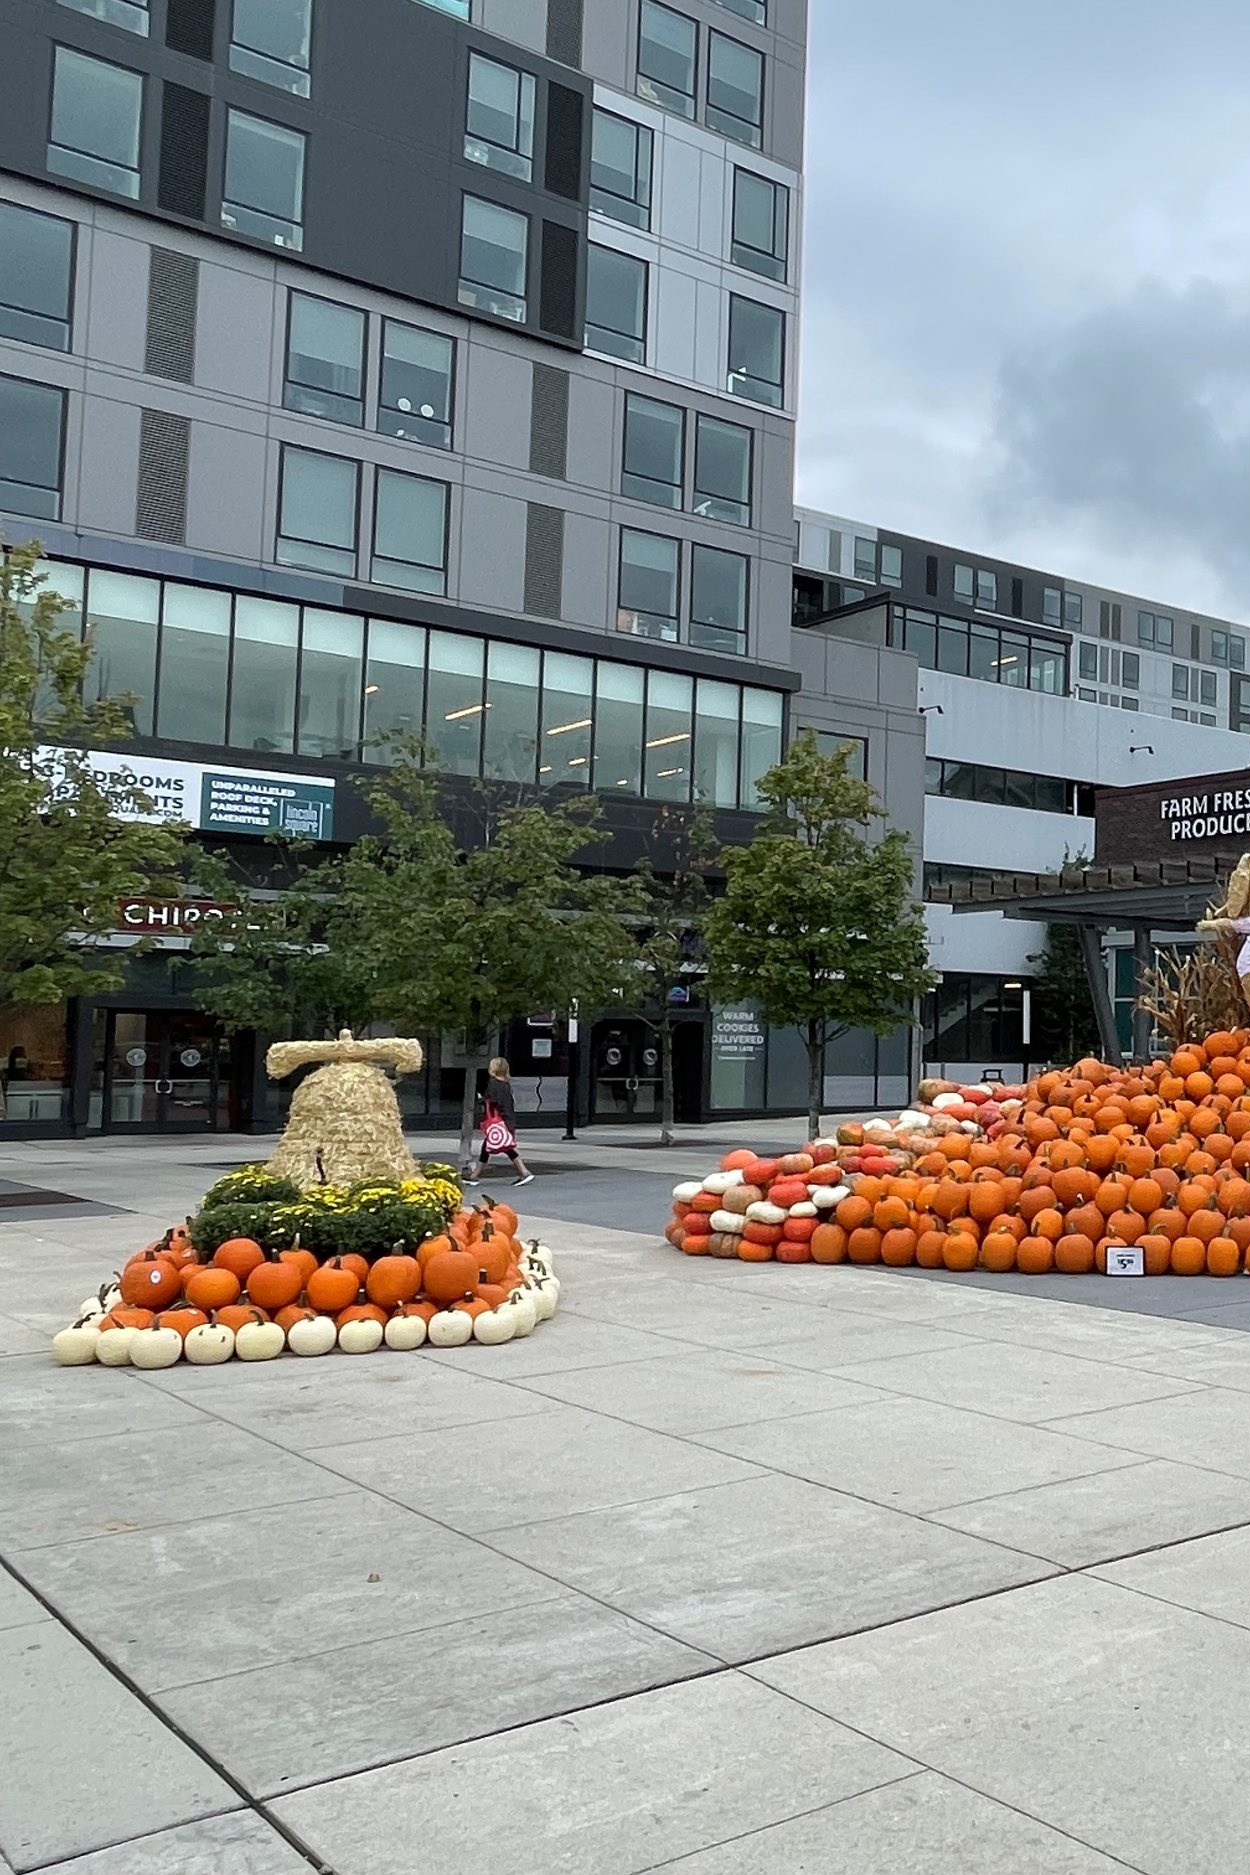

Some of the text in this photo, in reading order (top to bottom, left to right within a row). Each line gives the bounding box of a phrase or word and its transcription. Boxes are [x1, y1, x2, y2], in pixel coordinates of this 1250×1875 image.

[211, 780, 296, 797] UNPARALLELED
[211, 791, 242, 801] ROOF
[210, 802, 270, 815] PARKING &
[1160, 795, 1208, 819] FARM
[210, 812, 270, 826] AMENITIES
[722, 1011, 753, 1021] WARM
[716, 1023, 760, 1033] COOKIES
[712, 1034, 764, 1045] DELIVERED
